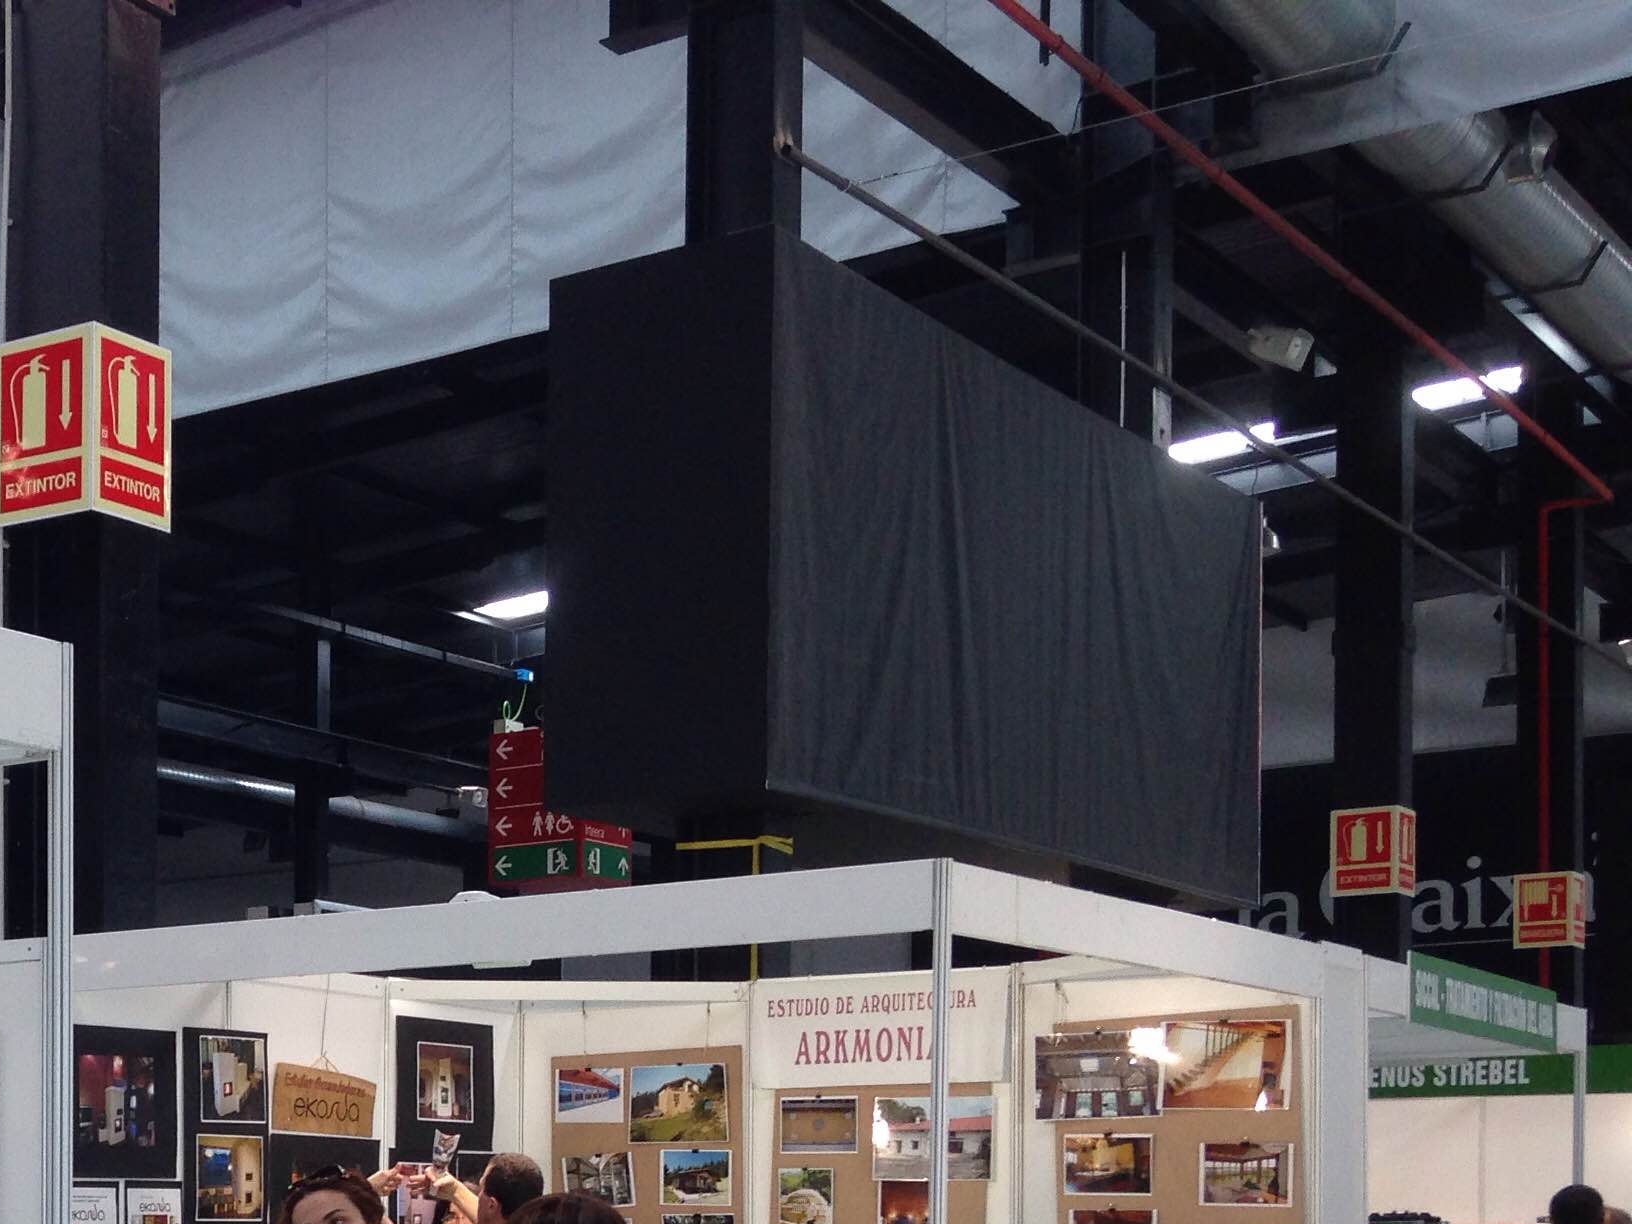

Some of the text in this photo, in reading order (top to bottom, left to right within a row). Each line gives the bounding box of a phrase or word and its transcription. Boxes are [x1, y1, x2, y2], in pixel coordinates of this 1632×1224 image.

[5, 472, 76, 500] EXTINTOR
[105, 471, 161, 503] EXTINTOR
[768, 989, 977, 1018] ESTUDIO DE ARQUITECURA
[795, 1026, 933, 1066] ARKMONI
[1433, 1058, 1530, 1087] STREBEL
